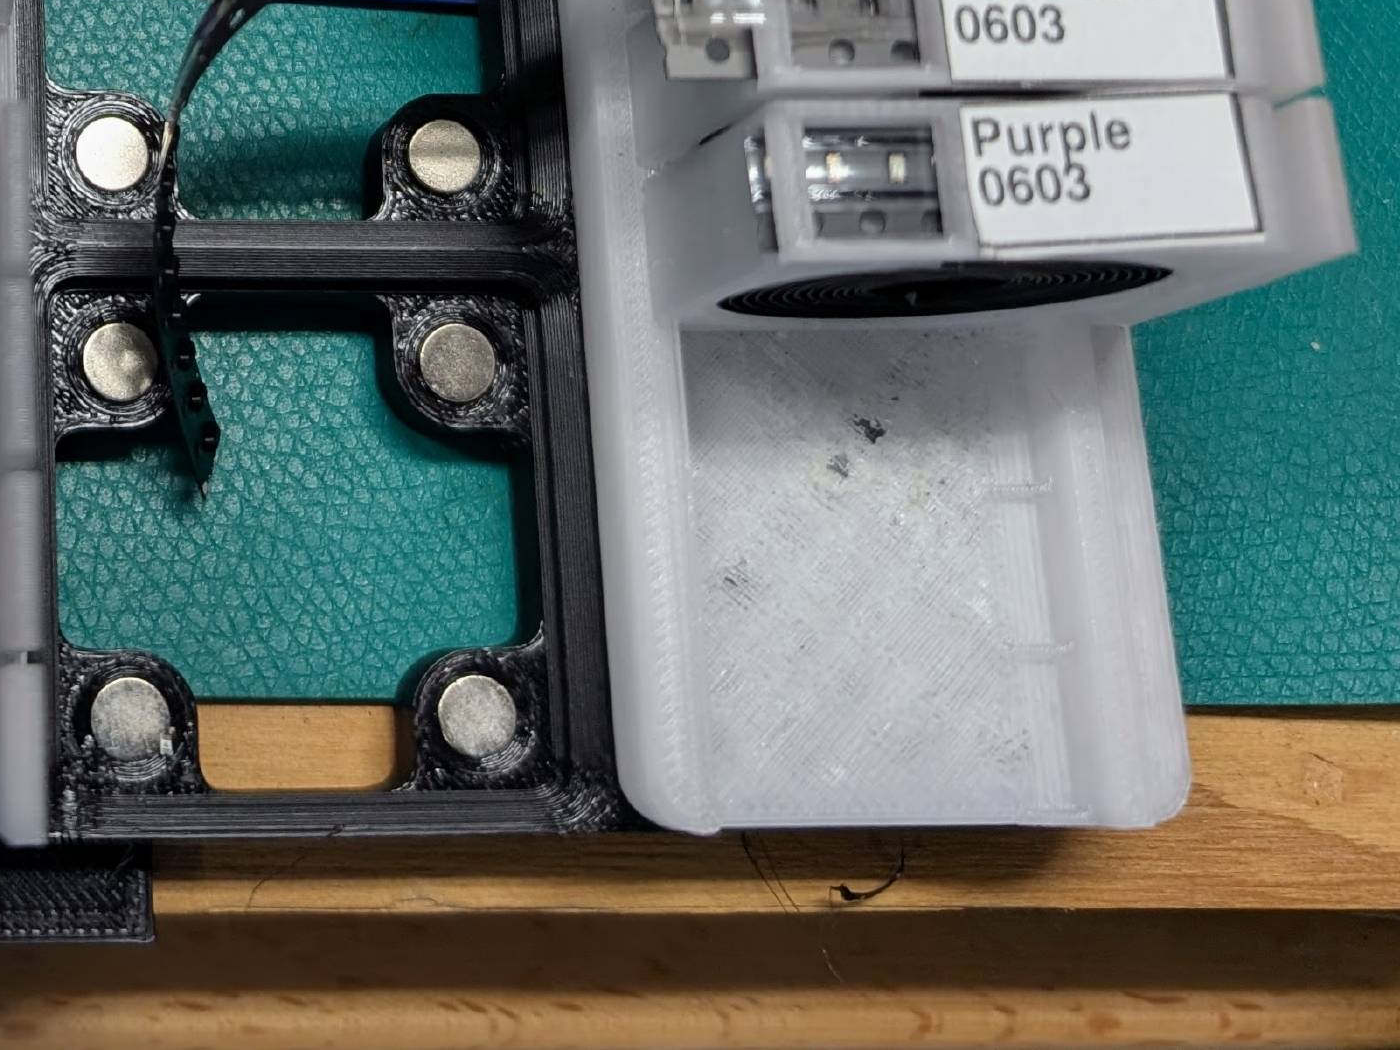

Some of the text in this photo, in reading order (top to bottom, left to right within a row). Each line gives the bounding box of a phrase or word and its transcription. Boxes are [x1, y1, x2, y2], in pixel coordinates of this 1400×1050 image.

[955, 4, 1065, 44] 0603
[971, 112, 1130, 166] Purple
[979, 164, 1091, 207] 0603
